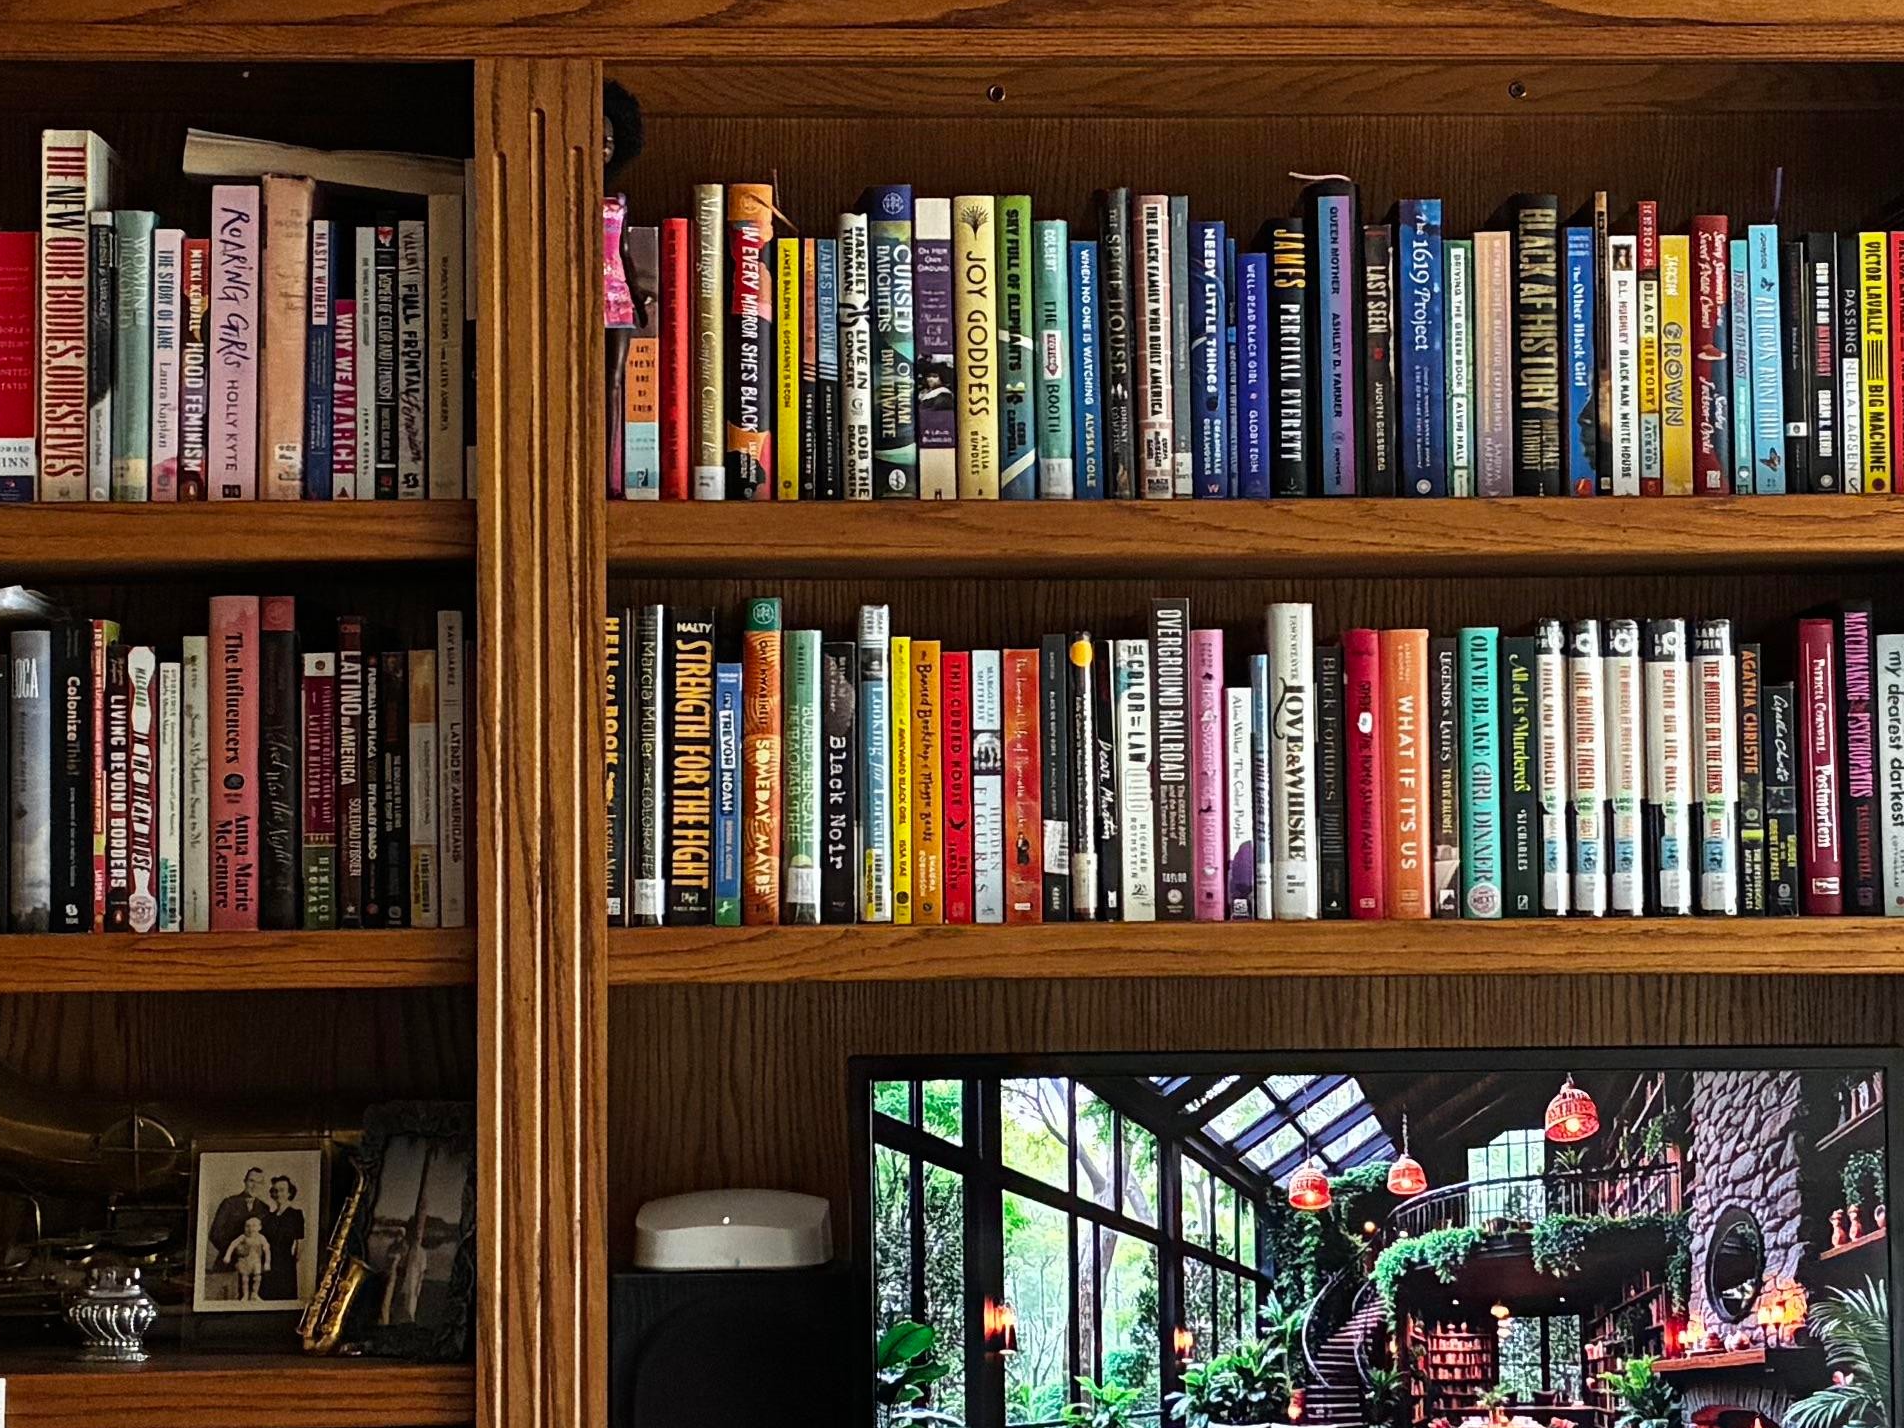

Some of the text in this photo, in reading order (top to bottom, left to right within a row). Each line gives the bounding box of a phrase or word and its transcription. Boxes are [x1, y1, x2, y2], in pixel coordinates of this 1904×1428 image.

[45, 145, 85, 181] THE
[45, 185, 85, 233] NEW
[45, 237, 85, 280] OUR
[157, 250, 174, 350] THE STORY OF JANE
[314, 233, 327, 272] NASTY
[314, 277, 327, 318] WOMEN
[855, 227, 867, 295] HARRIET
[1366, 266, 1388, 333] LAST SEEN
[1409, 240, 1433, 284] 1619
[1519, 208, 1559, 410] BLACK AF HISTORY
[741, 227, 759, 432] IN EVERY MIRROR SHE'S BLACK
[845, 331, 855, 389] CONCERT
[857, 330, 868, 390] LIVE IN
[966, 251, 989, 416] JOY GODDESS
[1080, 249, 1094, 405] WHEN NO ONE IS WATCHING
[1273, 229, 1306, 461] JAMES PERCIVAL EVERETT
[1411, 288, 1431, 351] Project
[1865, 242, 1885, 472] VICTOR LAVALLE BIG MACHINE
[183, 342, 204, 471] HOOD FEMINISM
[334, 313, 354, 475] WHY WE MARCH
[224, 632, 242, 764] The Influencers
[1156, 609, 1185, 781] OVERGROUND RAILROAD
[1742, 650, 1758, 775] AGATHA CHRISTIE
[1885, 651, 1903, 678] my
[110, 695, 127, 888] LIVING BEYOND BORDERS
[672, 640, 711, 889] STRENGTH FOR THE FIGHT
[721, 713, 733, 811] TREVOR NOAH
[829, 735, 846, 870] Black Noir
[1398, 695, 1417, 869] WHAT IF IT'S US
[1470, 636, 1496, 882] OLIVIE BLAKE GIRL DINNER
